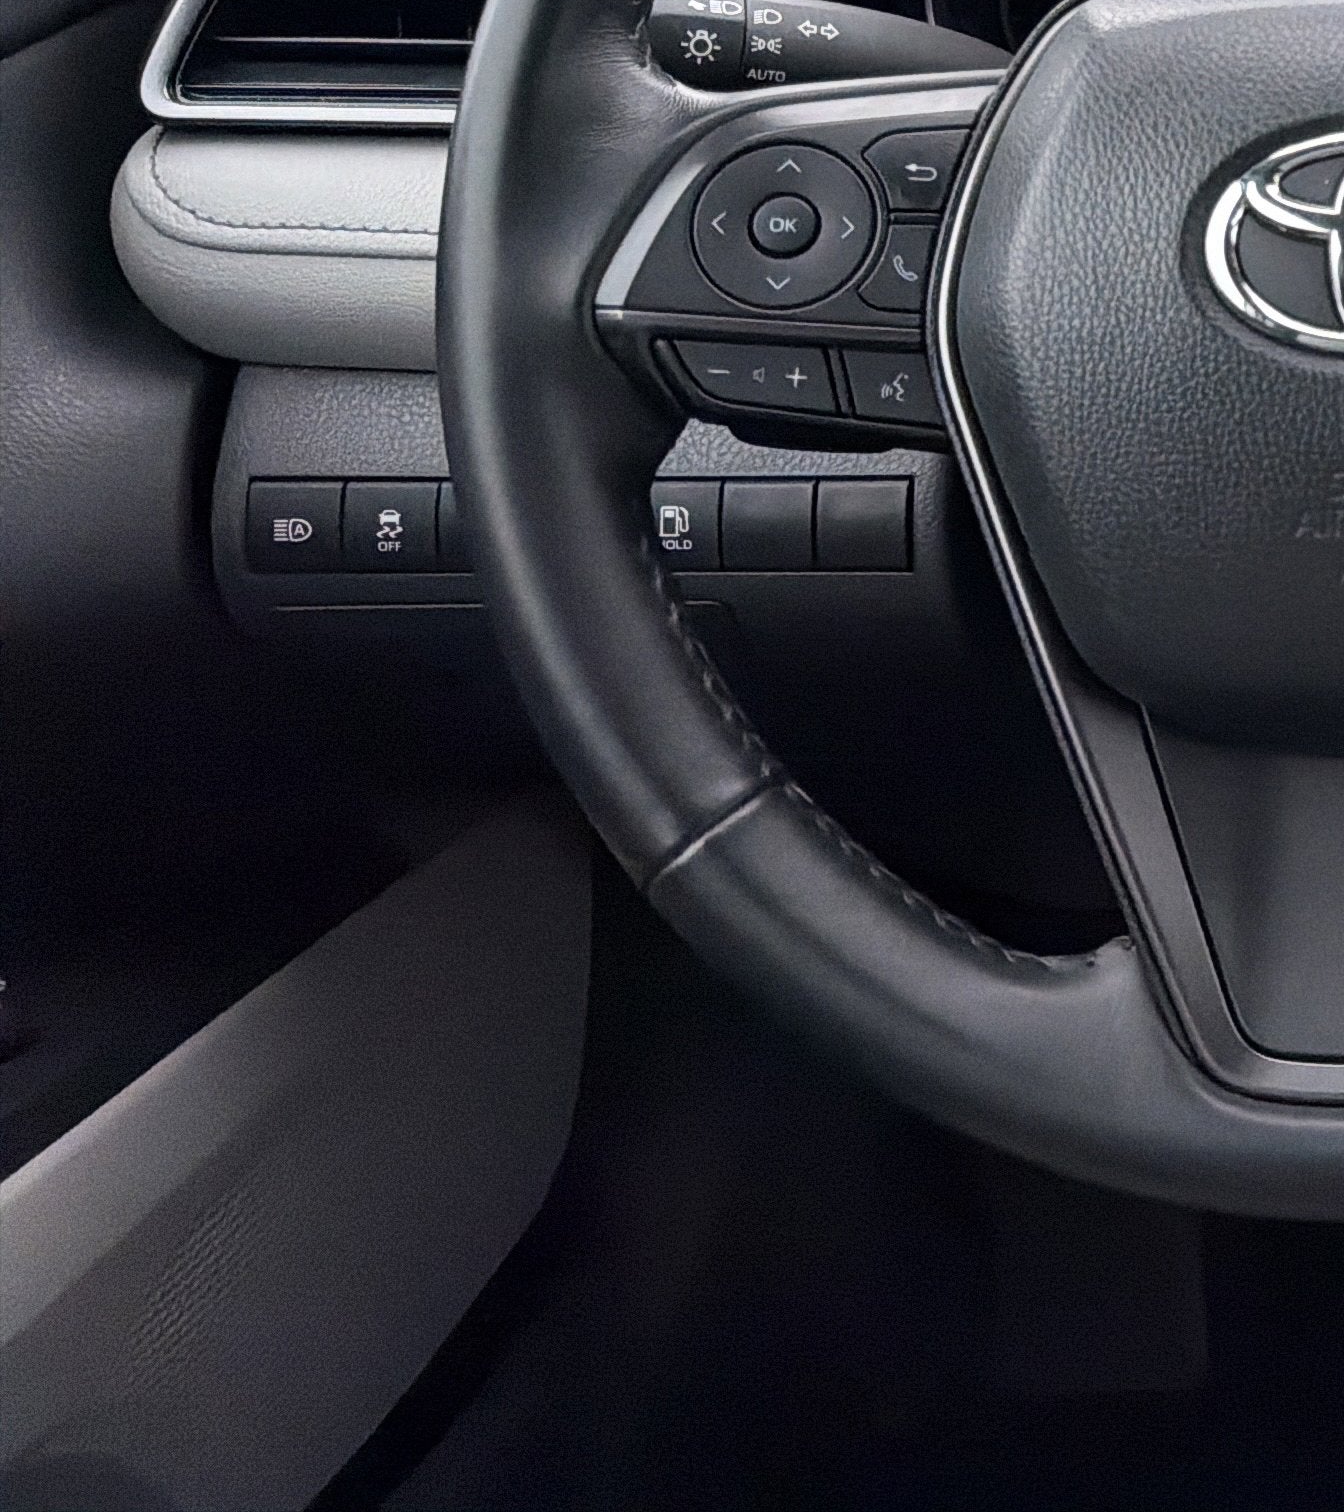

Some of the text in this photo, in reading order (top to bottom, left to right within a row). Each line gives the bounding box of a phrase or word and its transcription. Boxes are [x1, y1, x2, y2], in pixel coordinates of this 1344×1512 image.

[747, 67, 786, 83] AUTO
[769, 217, 798, 233] OK
[377, 541, 401, 552] OFF
